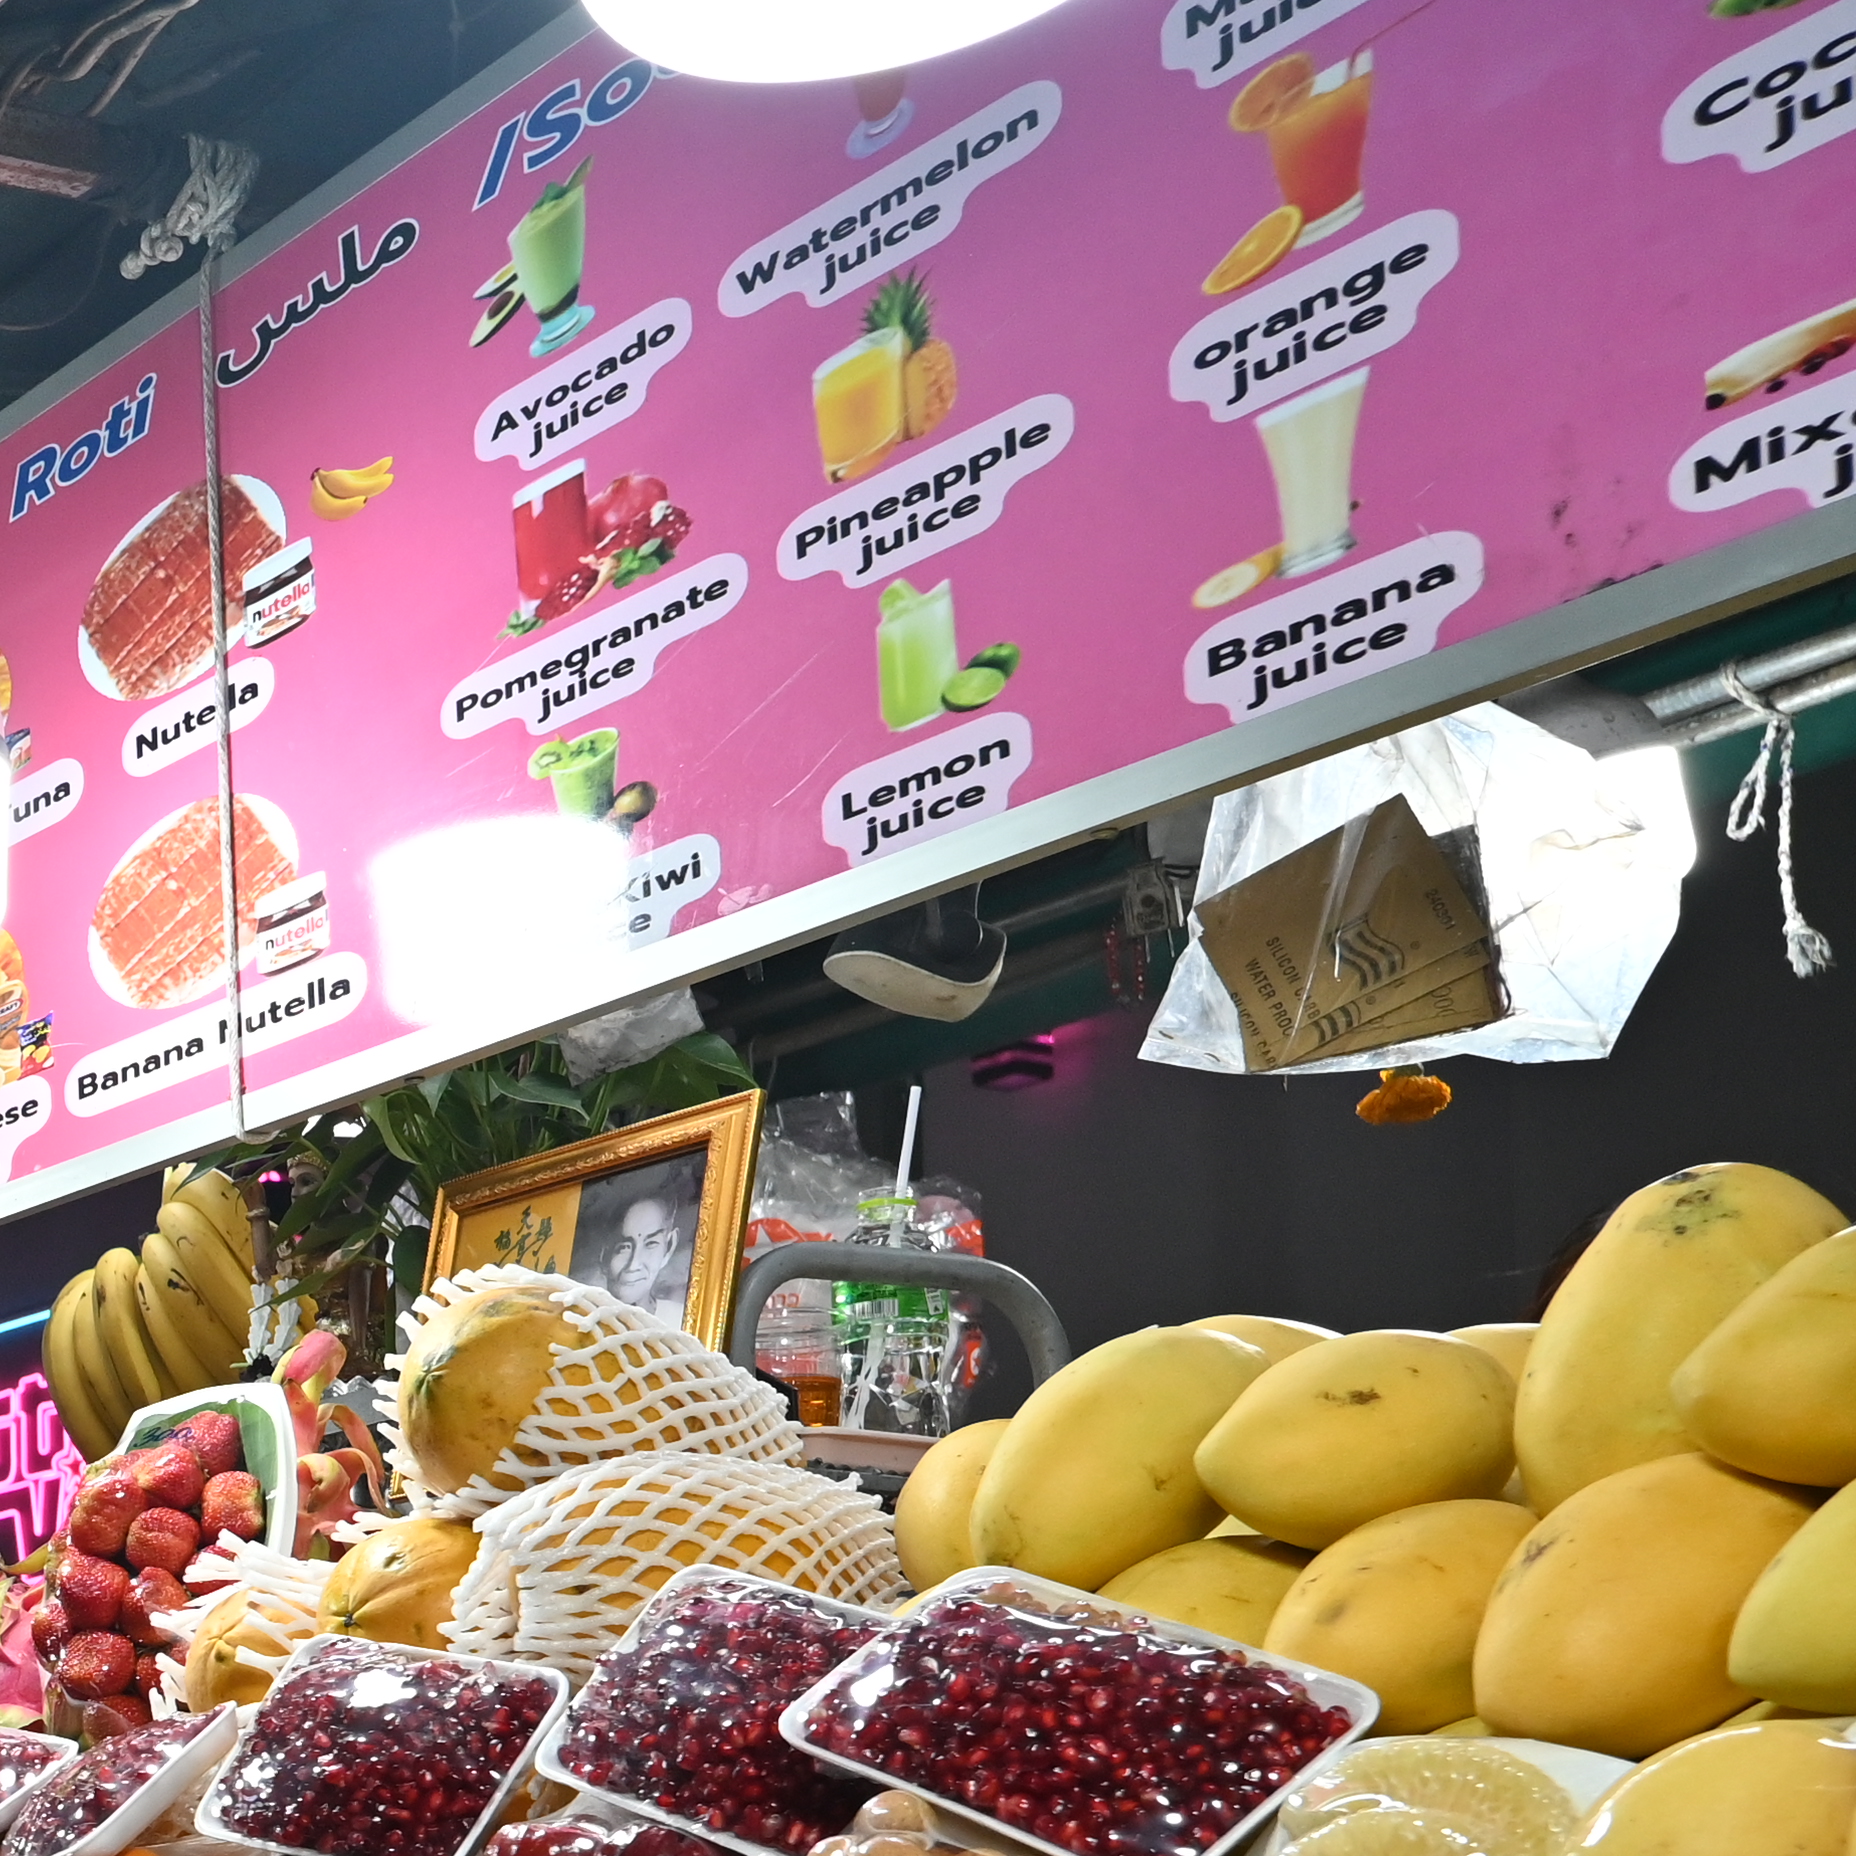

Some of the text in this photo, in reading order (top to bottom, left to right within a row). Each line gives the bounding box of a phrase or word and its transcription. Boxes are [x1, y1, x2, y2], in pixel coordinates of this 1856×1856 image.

[734, 107, 1039, 297] Watermelon
[819, 204, 941, 295] juice
[1192, 240, 1430, 371] orange
[489, 320, 675, 442] Avocado
[1227, 300, 1389, 406] juice
[8, 373, 157, 524] Roti
[528, 380, 629, 458] juice
[794, 416, 1052, 560] Pineapple
[854, 490, 981, 575] juice
[252, 580, 311, 622] nutella
[1206, 561, 1456, 678] Banana
[454, 574, 730, 722] Pomegranate
[536, 655, 636, 723] juice
[1246, 620, 1408, 710] juice
[134, 676, 259, 760] Nutela
[10, 780, 71, 823] una
[841, 738, 1010, 820] Lemon
[862, 784, 986, 856] juice
[265, 915, 324, 951] nutella
[1245, 958, 1276, 1003] WATER
[76, 1034, 203, 1101] Banana
